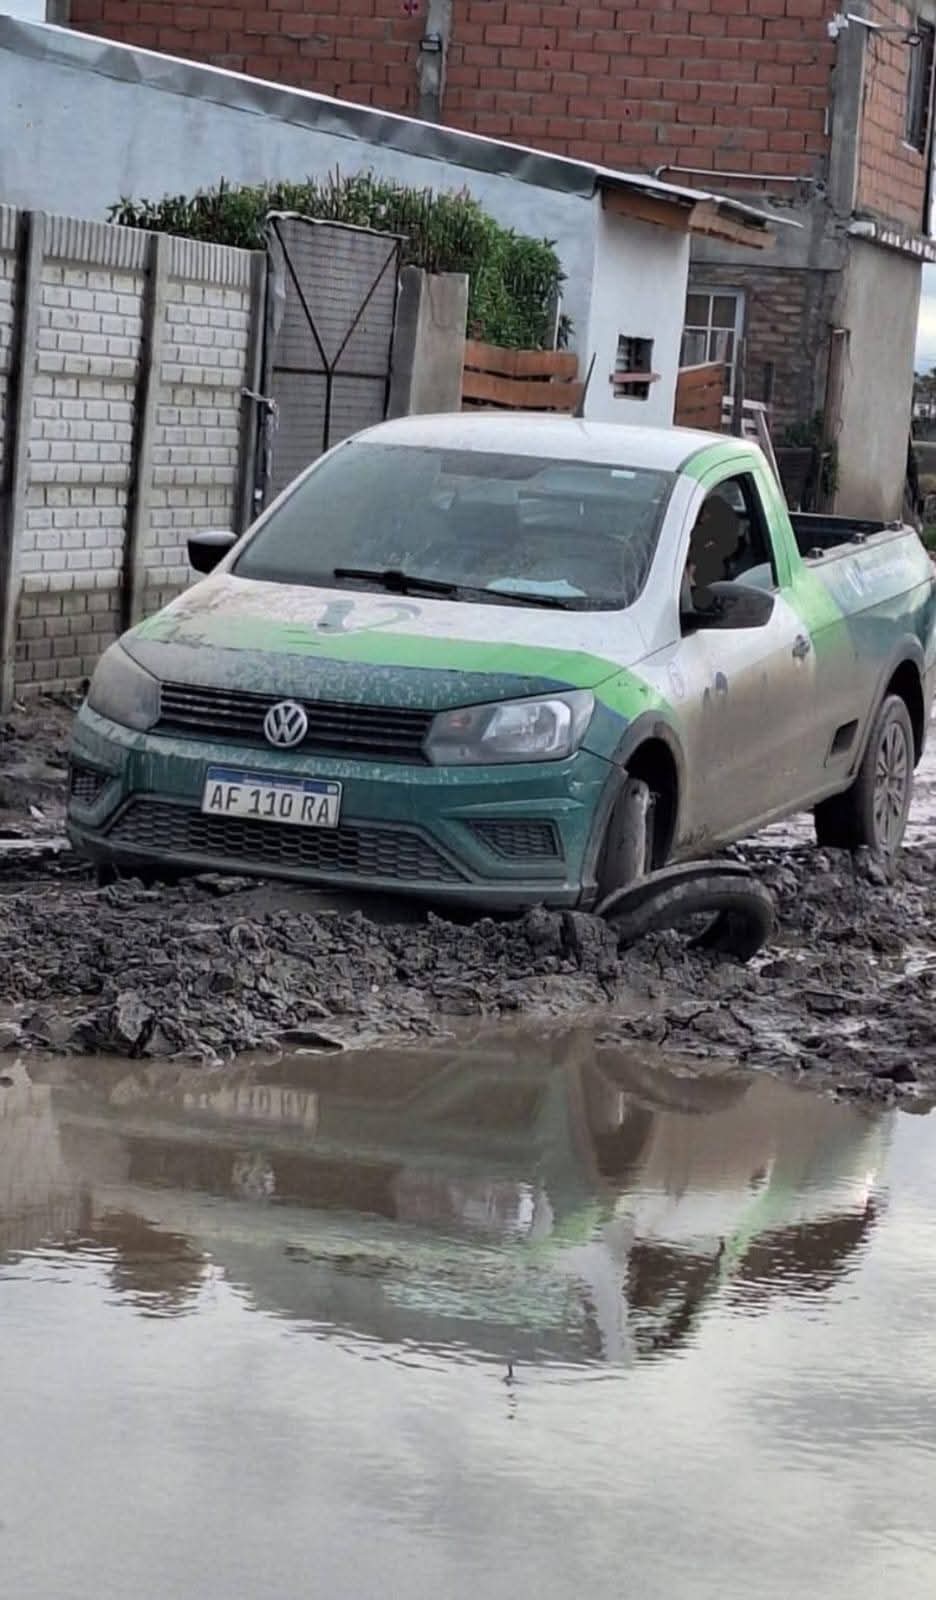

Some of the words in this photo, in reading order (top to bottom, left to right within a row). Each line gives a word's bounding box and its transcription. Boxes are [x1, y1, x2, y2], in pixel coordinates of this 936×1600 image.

[264, 702, 307, 747] VW
[210, 784, 241, 810] AF
[248, 789, 293, 817] 110
[300, 795, 329, 825] RA
